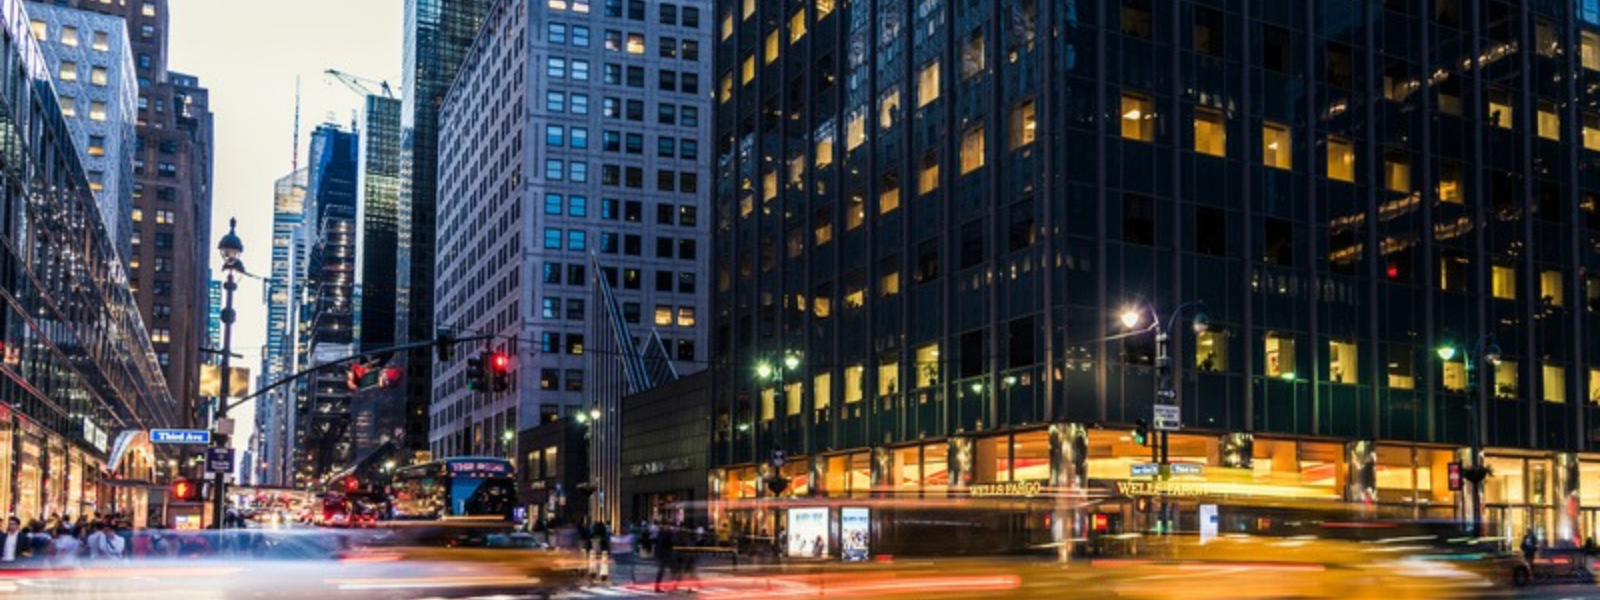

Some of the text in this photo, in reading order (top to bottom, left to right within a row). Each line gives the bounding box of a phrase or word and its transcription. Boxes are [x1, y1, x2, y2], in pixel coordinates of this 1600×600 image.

[158, 432, 203, 441] Third Ave
[969, 481, 1041, 497] WELLS FARGO
[1117, 482, 1162, 497] WELLS
